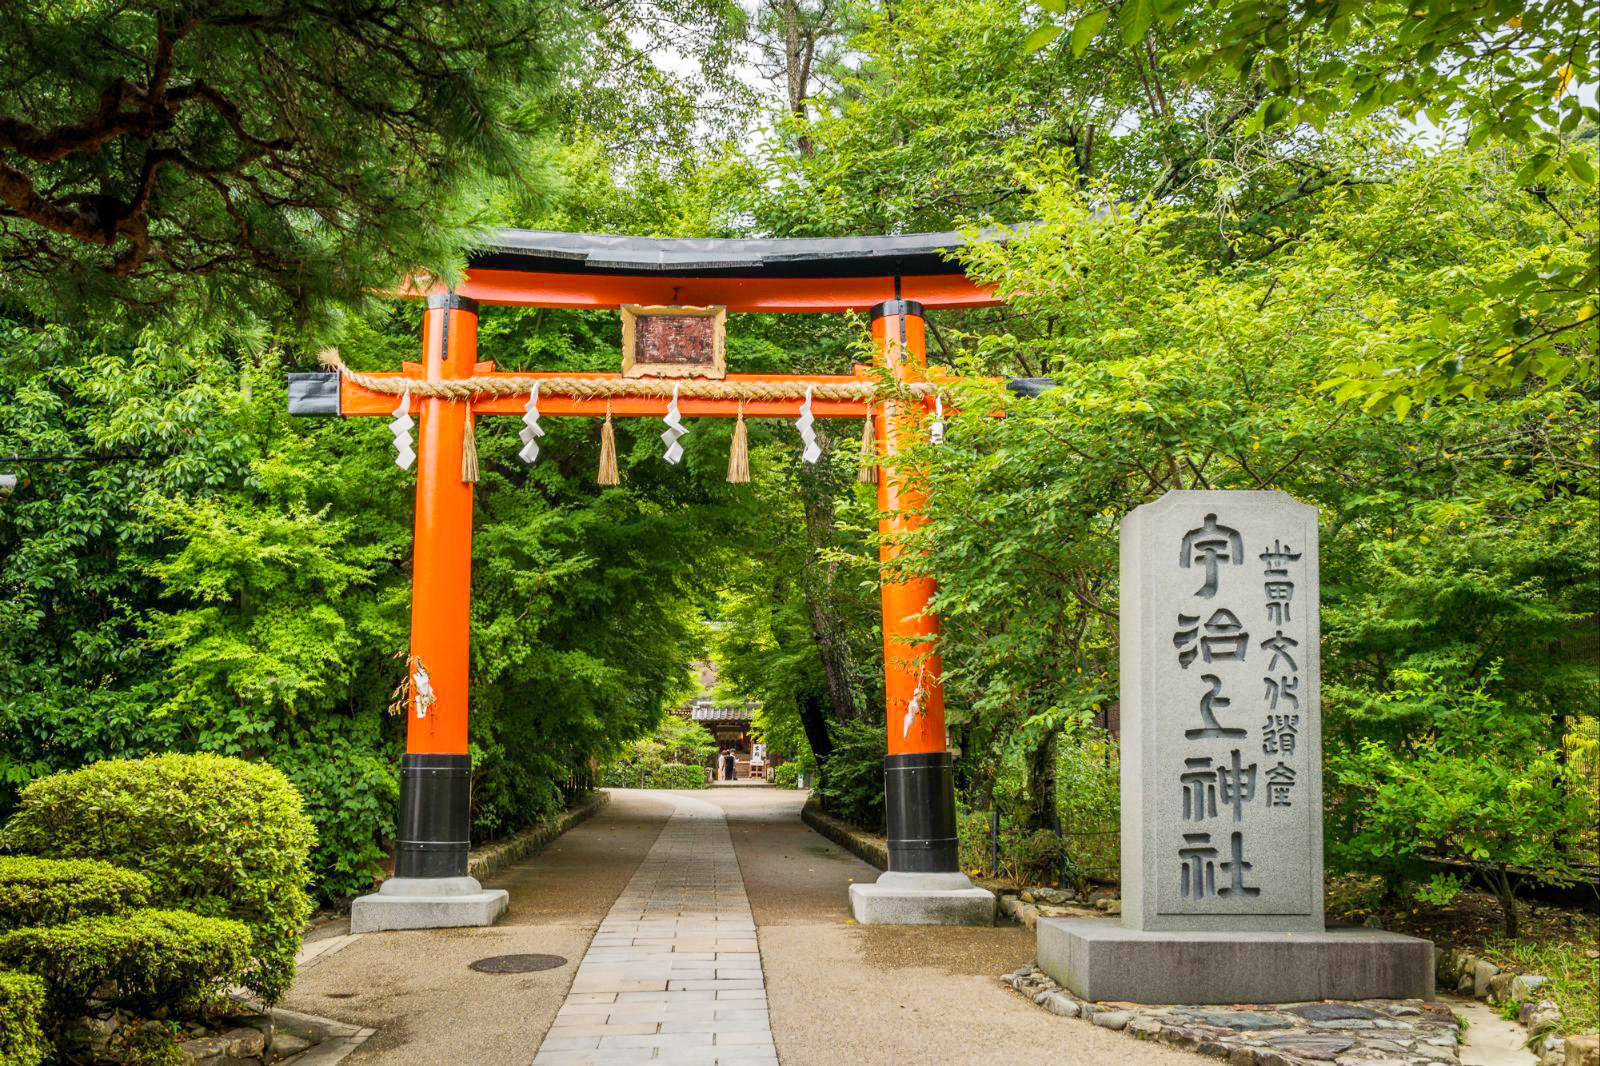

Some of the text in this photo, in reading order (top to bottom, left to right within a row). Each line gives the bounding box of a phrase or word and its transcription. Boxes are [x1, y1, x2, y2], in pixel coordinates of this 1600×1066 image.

[1173, 512, 1261, 901] 宇治上神社
[1259, 539, 1302, 808] 世界文化遺産
